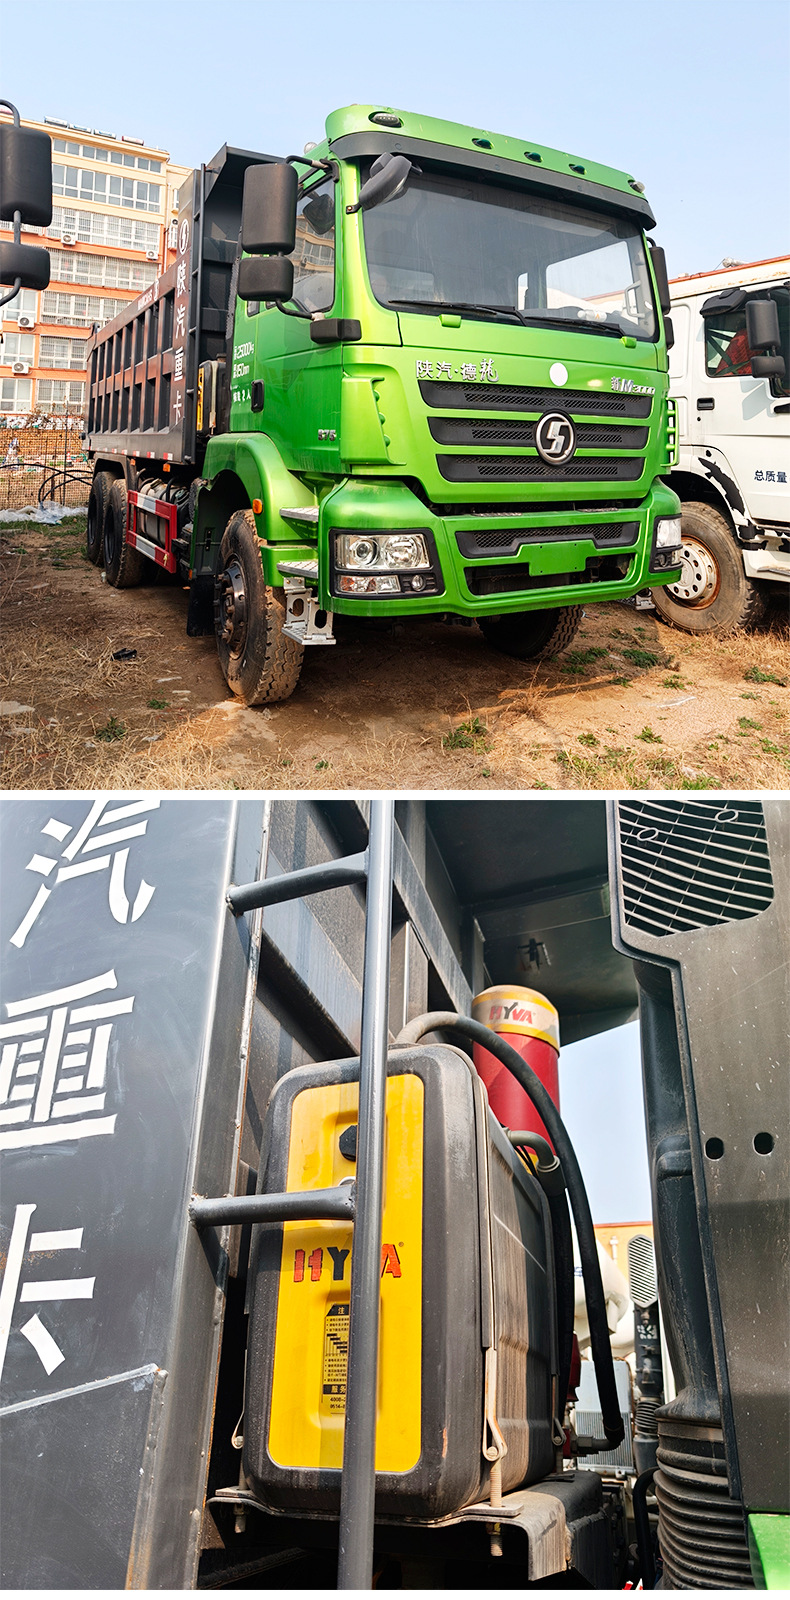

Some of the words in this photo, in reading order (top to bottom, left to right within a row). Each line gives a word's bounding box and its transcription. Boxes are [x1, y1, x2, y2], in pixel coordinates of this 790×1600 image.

[173, 260, 187, 425] 陕汽重卡
[754, 469, 788, 483] 总质量
[489, 1002, 533, 1024] HYVA
[293, 1243, 402, 1282] HYA
